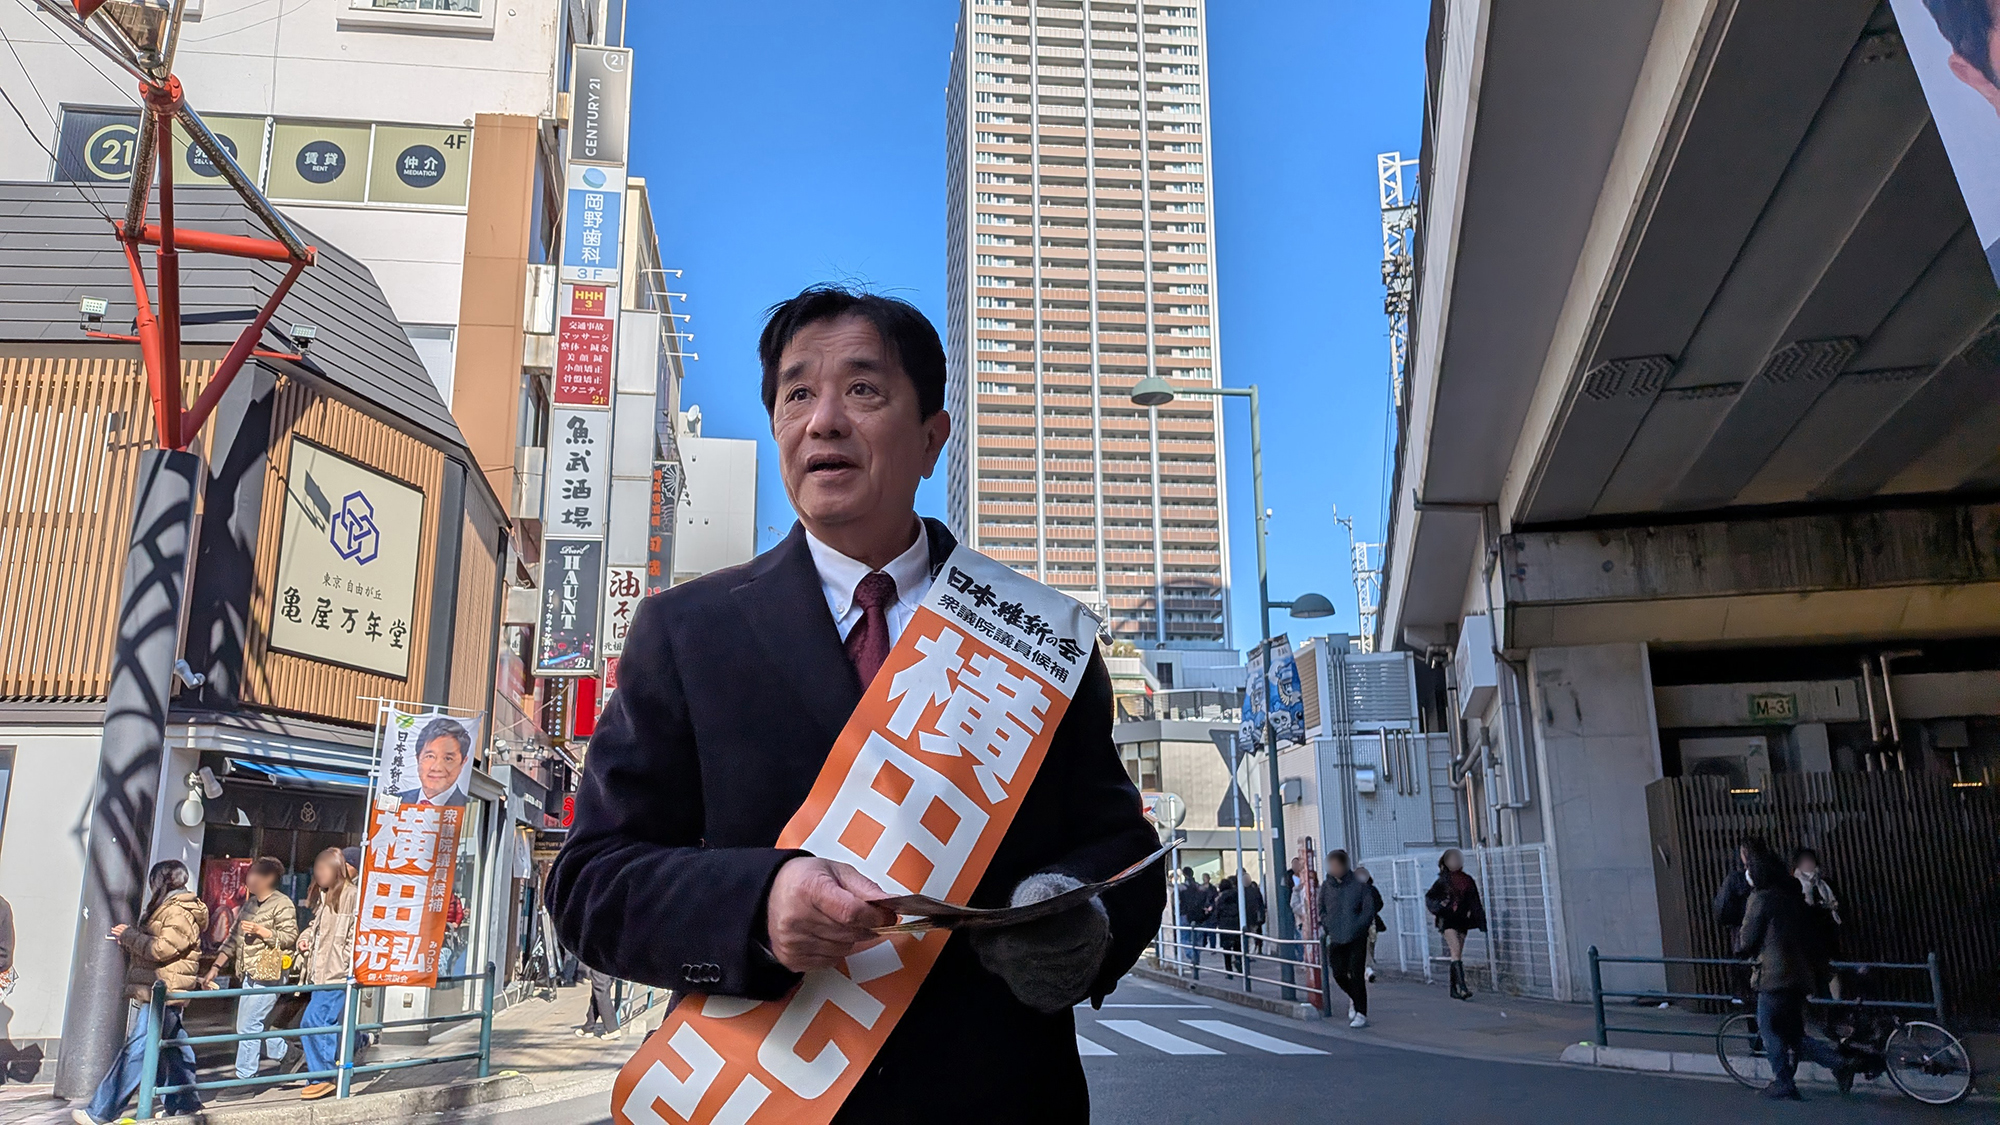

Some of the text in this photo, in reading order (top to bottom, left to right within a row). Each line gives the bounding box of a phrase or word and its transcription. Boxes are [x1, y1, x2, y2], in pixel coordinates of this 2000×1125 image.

[611, 54, 624, 66] 21
[585, 78, 601, 157] CENTURY 21
[443, 133, 468, 150] 4F
[100, 138, 134, 166] 21
[304, 151, 339, 166] 賃貸
[403, 155, 438, 171] 仲介
[403, 169, 438, 177] MEDIATION
[581, 193, 604, 265] 岡野歯科
[577, 268, 603, 280] 3F
[575, 290, 604, 301] HHH
[584, 300, 593, 308] 3
[568, 320, 605, 331] 交通事故
[561, 332, 610, 342] マッサージ
[564, 363, 603, 374] 小顔矯正
[563, 374, 603, 385] 骨盤矯正
[561, 385, 604, 396] マタニティ
[592, 395, 608, 405] 2F
[560, 415, 594, 530] 魚武酒場
[321, 571, 383, 601] 東京 自由が丘
[560, 555, 582, 630] HAUNT
[609, 570, 641, 640] 油そば
[281, 586, 407, 649] 亀屋万年堂
[946, 565, 1089, 666] 日本維新の会
[937, 593, 1070, 684] 衆議院議員候補
[574, 657, 592, 669] B1
[1756, 700, 1791, 716] M-31
[387, 730, 409, 796] 日本維新の会
[428, 809, 459, 914] 衆議院議員候補
[359, 807, 441, 936] 横田
[354, 932, 426, 974] 光弘
[425, 940, 438, 974] みつひろ
[367, 973, 409, 984] 個人演説会
